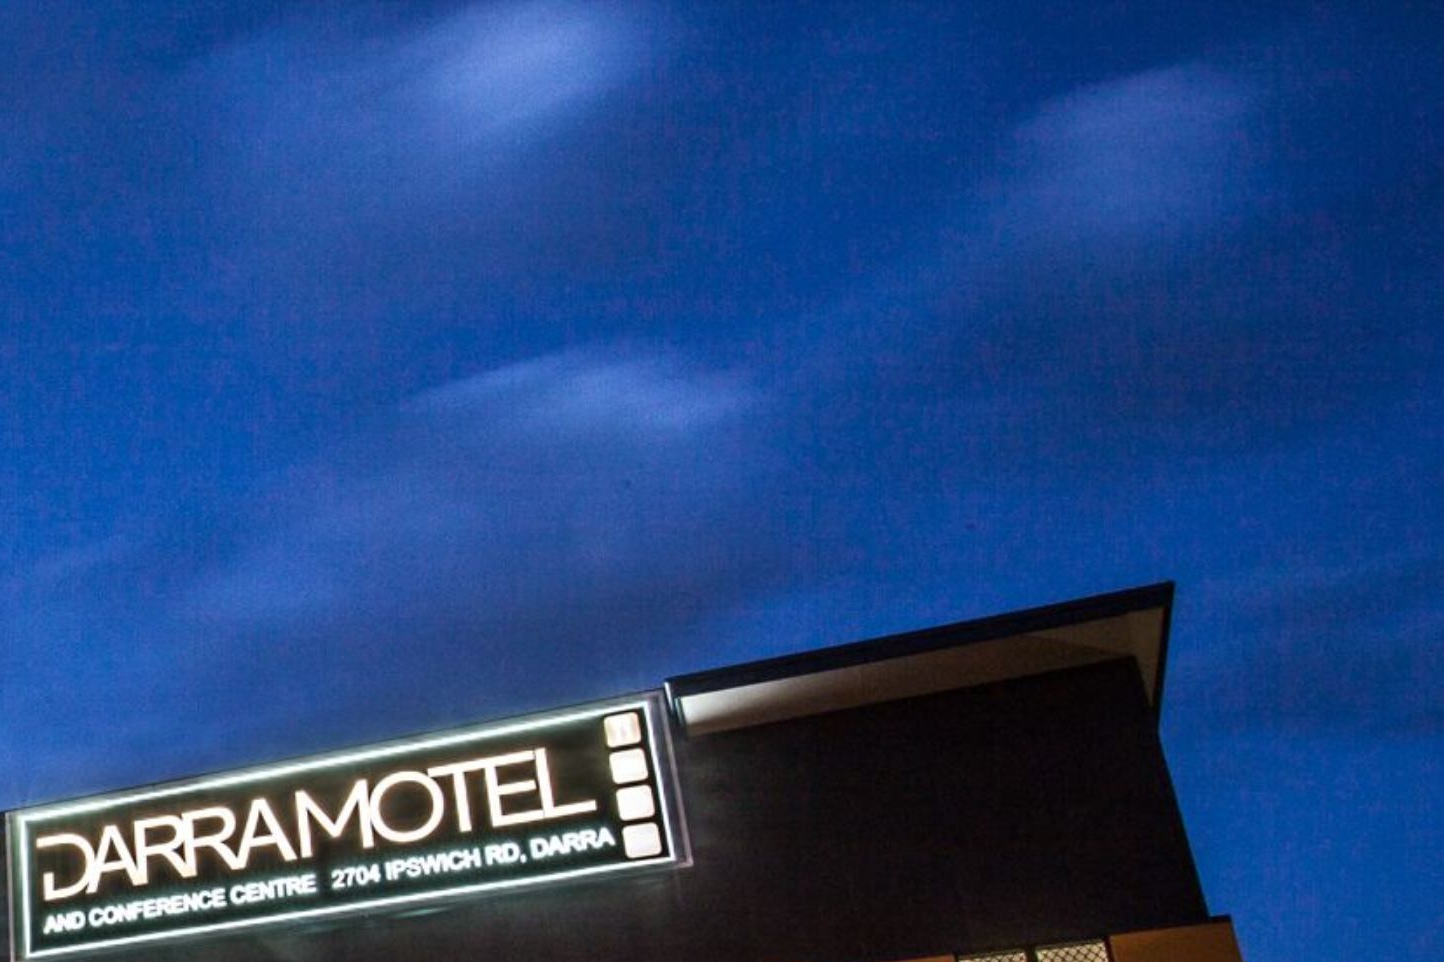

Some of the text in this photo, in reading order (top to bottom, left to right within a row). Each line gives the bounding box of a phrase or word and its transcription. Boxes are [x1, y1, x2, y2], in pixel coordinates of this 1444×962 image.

[43, 827, 616, 934] AND CONFERENCE CENTRE 2704 IPSWICH RD, DARRA
